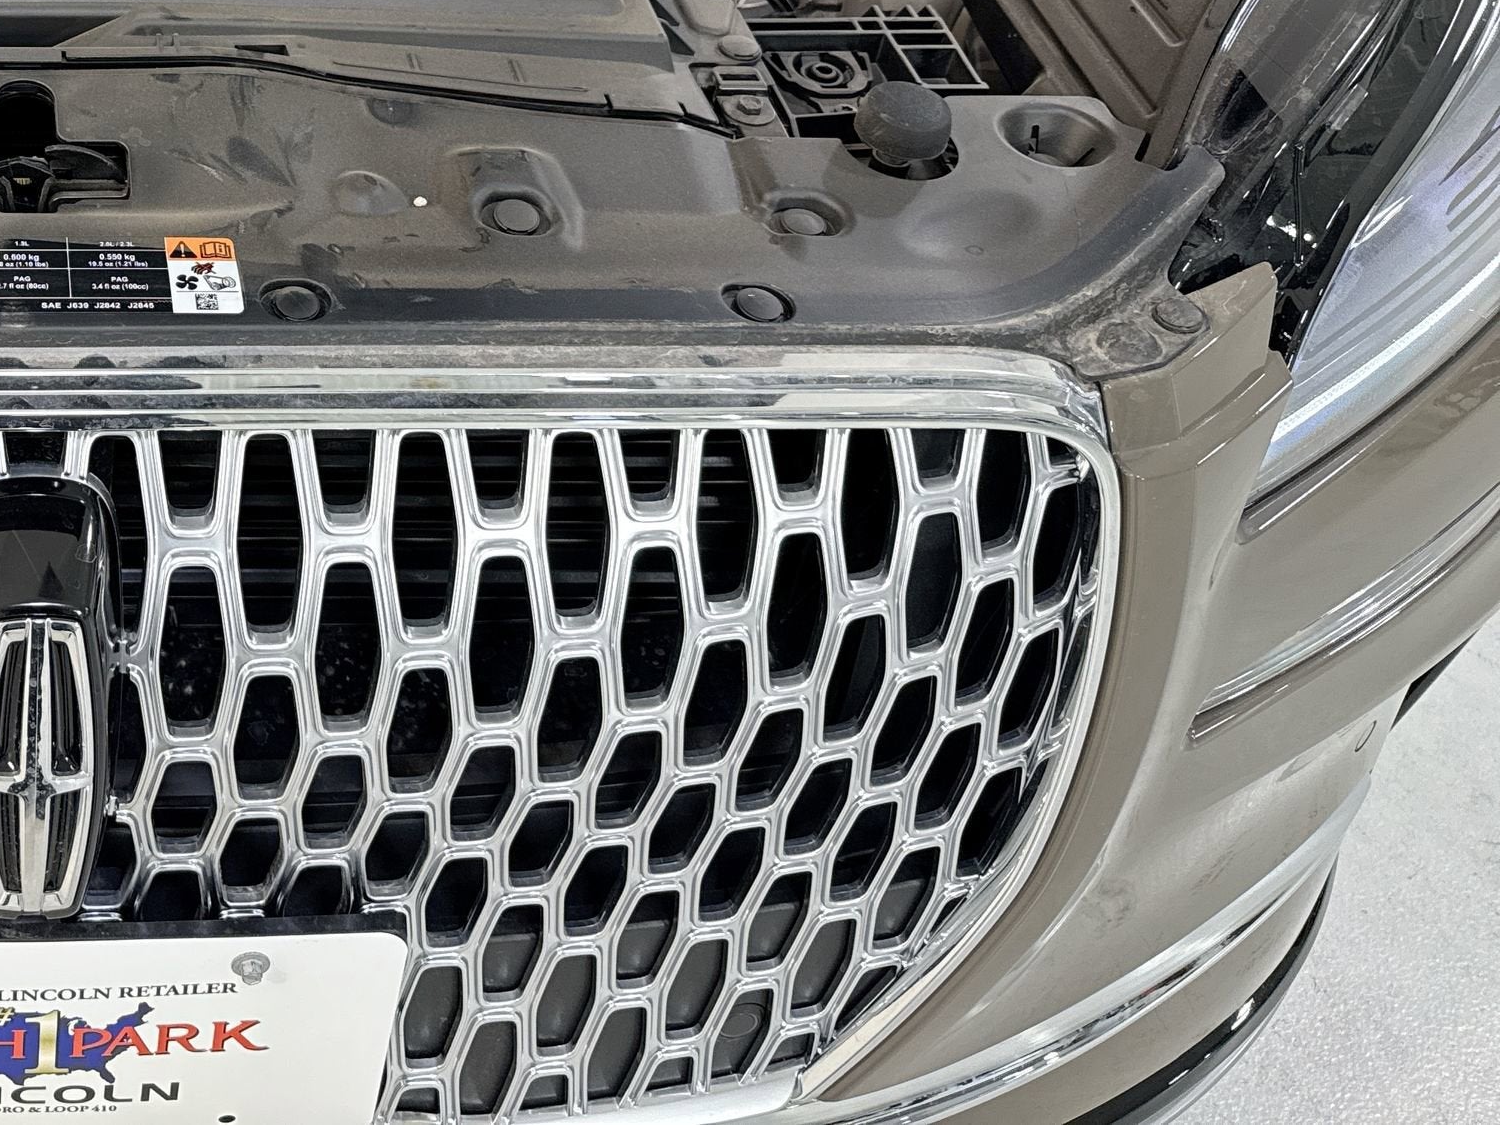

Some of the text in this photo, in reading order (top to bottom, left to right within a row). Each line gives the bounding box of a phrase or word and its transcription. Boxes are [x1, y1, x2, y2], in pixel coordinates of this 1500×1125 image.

[28, 253, 40, 262] kg
[99, 253, 136, 262] 0.550 kg
[121, 283, 149, 291] (100cc)
[118, 982, 239, 999] RETAILER
[69, 1019, 270, 1059] PARK
[28, 1105, 42, 1114] &
[45, 1104, 91, 1114] LOOP
[92, 1104, 117, 1113] 410
